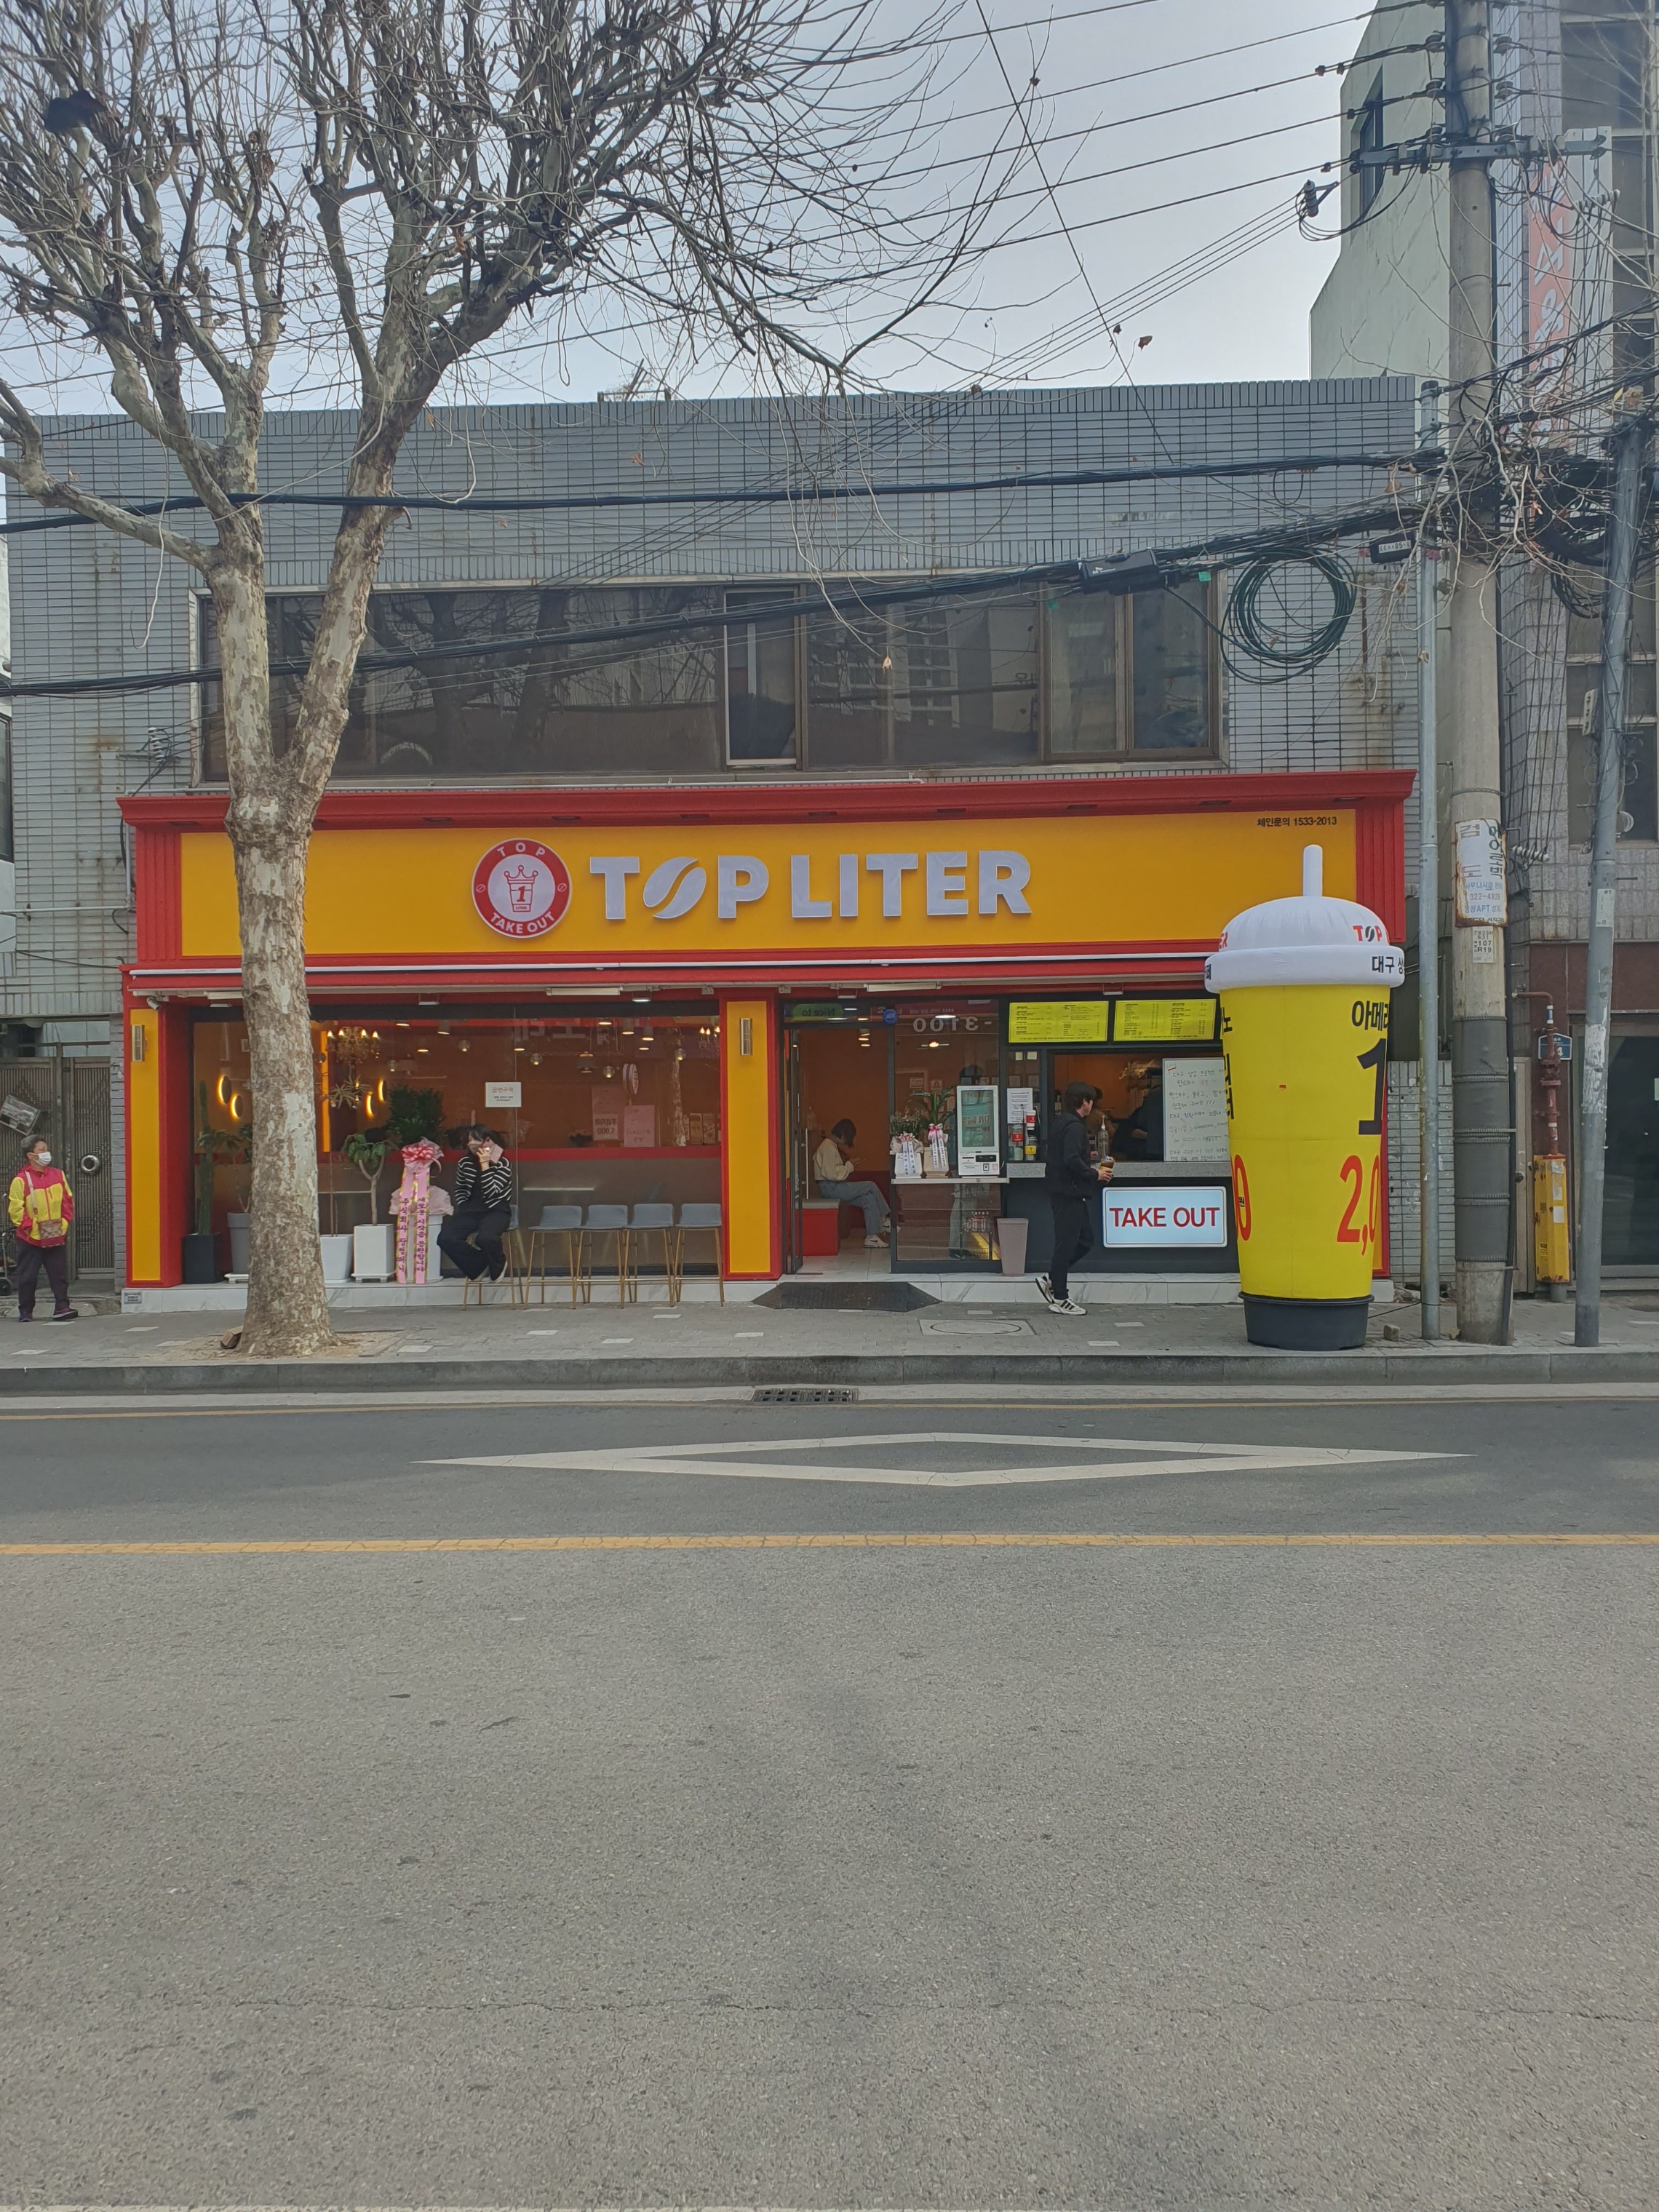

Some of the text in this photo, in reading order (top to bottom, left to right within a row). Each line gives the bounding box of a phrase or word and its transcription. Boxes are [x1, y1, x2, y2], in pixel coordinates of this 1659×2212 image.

[1257, 816, 1337, 827] 체인문의 1533-2013
[497, 842, 545, 857] TOP
[589, 850, 1033, 920] TOP LITER
[490, 911, 554, 934] TAKE OUT
[1372, 955, 1395, 974] 대구
[1109, 1207, 1220, 1228] TAKE OUT
